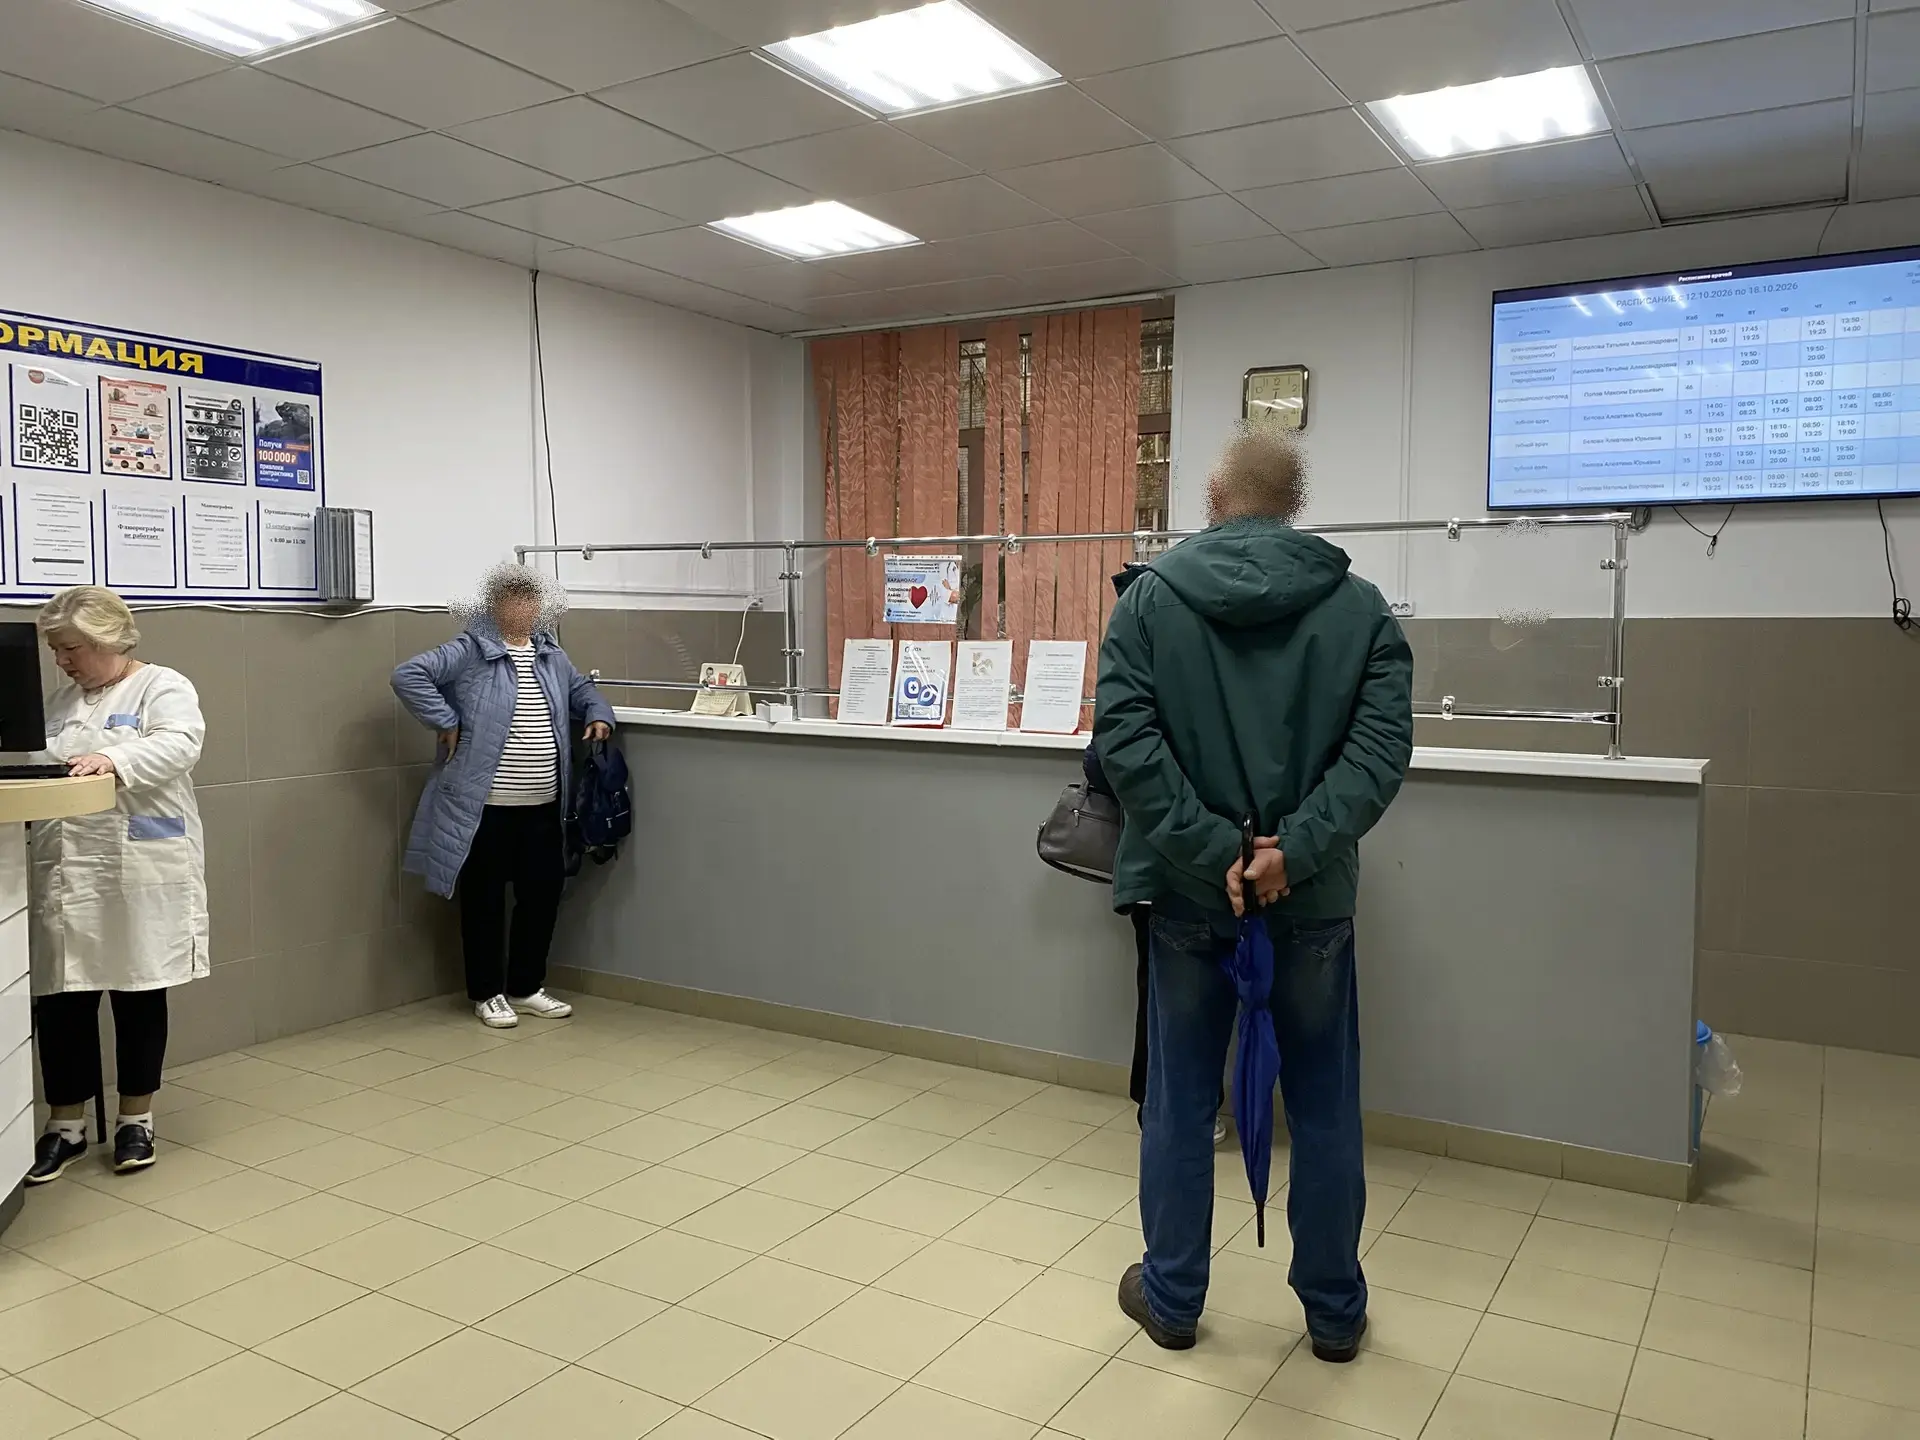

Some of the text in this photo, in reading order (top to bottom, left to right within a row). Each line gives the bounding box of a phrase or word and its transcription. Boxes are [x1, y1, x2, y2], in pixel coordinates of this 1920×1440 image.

[1616, 295, 1676, 307] РАСПИСАНИЕ
[1686, 289, 1733, 301] 12.10.2026
[1735, 289, 1746, 297] по
[1749, 282, 1798, 294] 18.10.2026
[259, 439, 282, 450] Получи
[118, 524, 164, 532] Флюорография
